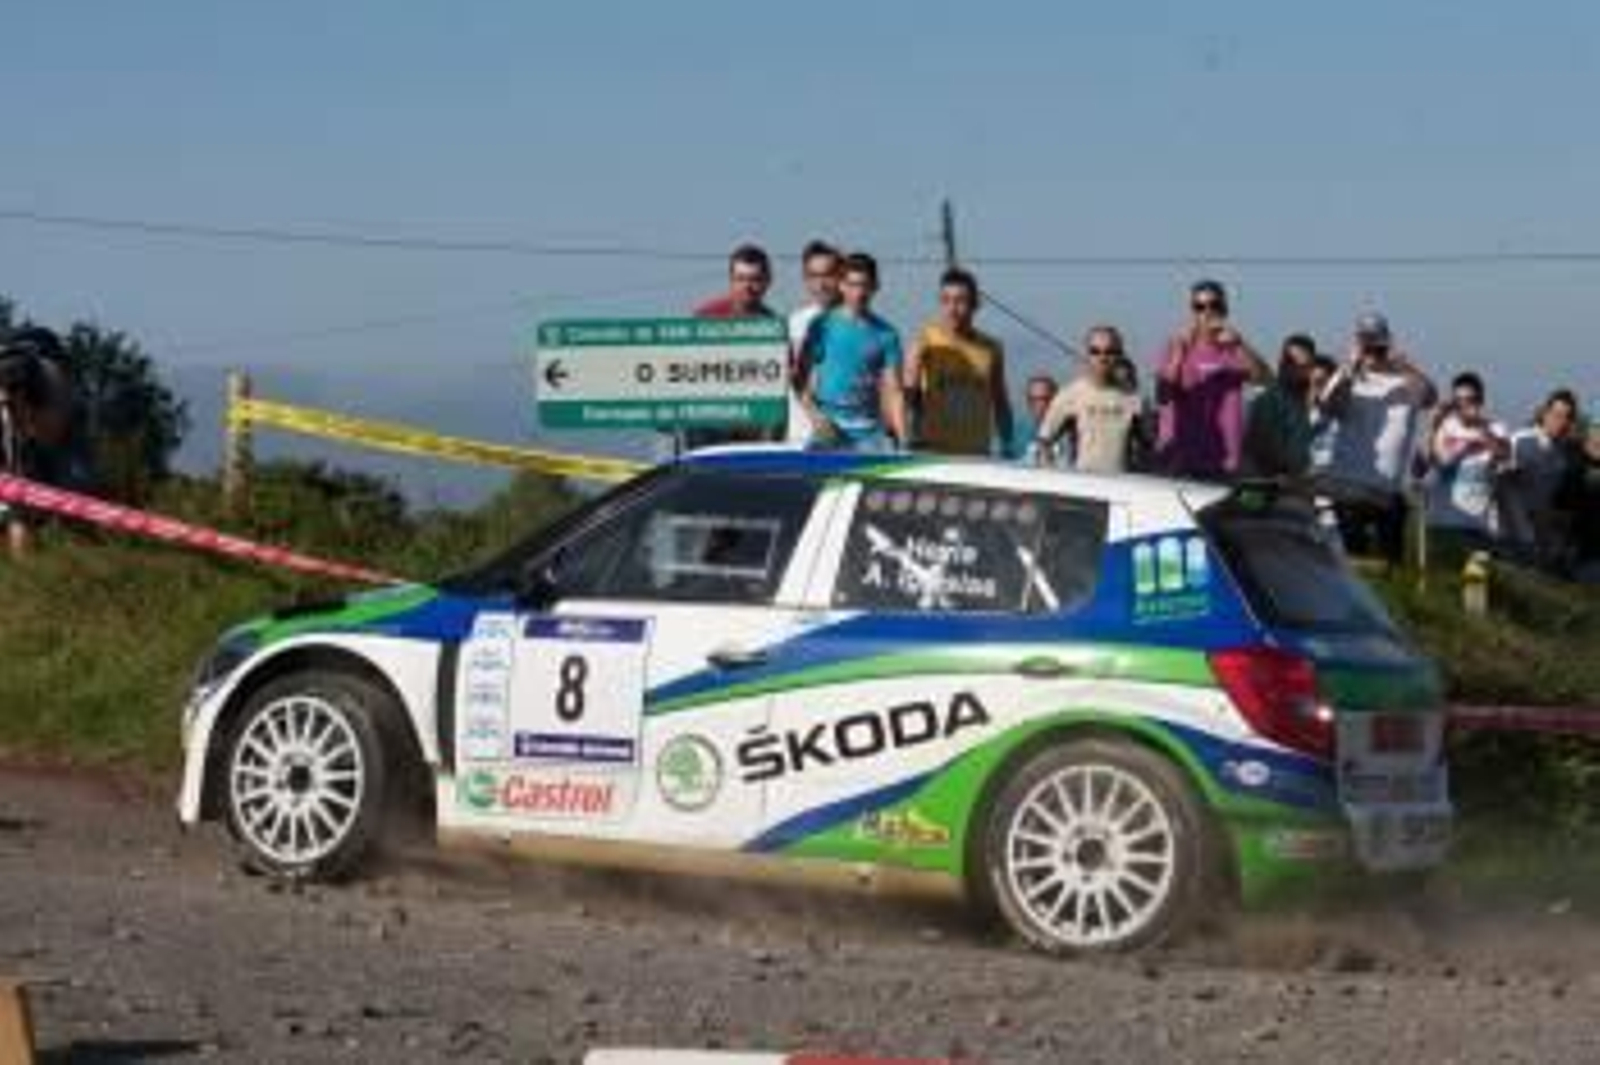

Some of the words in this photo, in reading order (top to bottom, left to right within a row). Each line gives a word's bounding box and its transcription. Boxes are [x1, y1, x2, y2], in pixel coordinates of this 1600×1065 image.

[636, 362, 655, 384] O
[666, 359, 781, 384] SUMEIRO
[555, 654, 589, 723] 8
[736, 691, 992, 784] ŠKODA
[501, 774, 614, 813] Castrol
